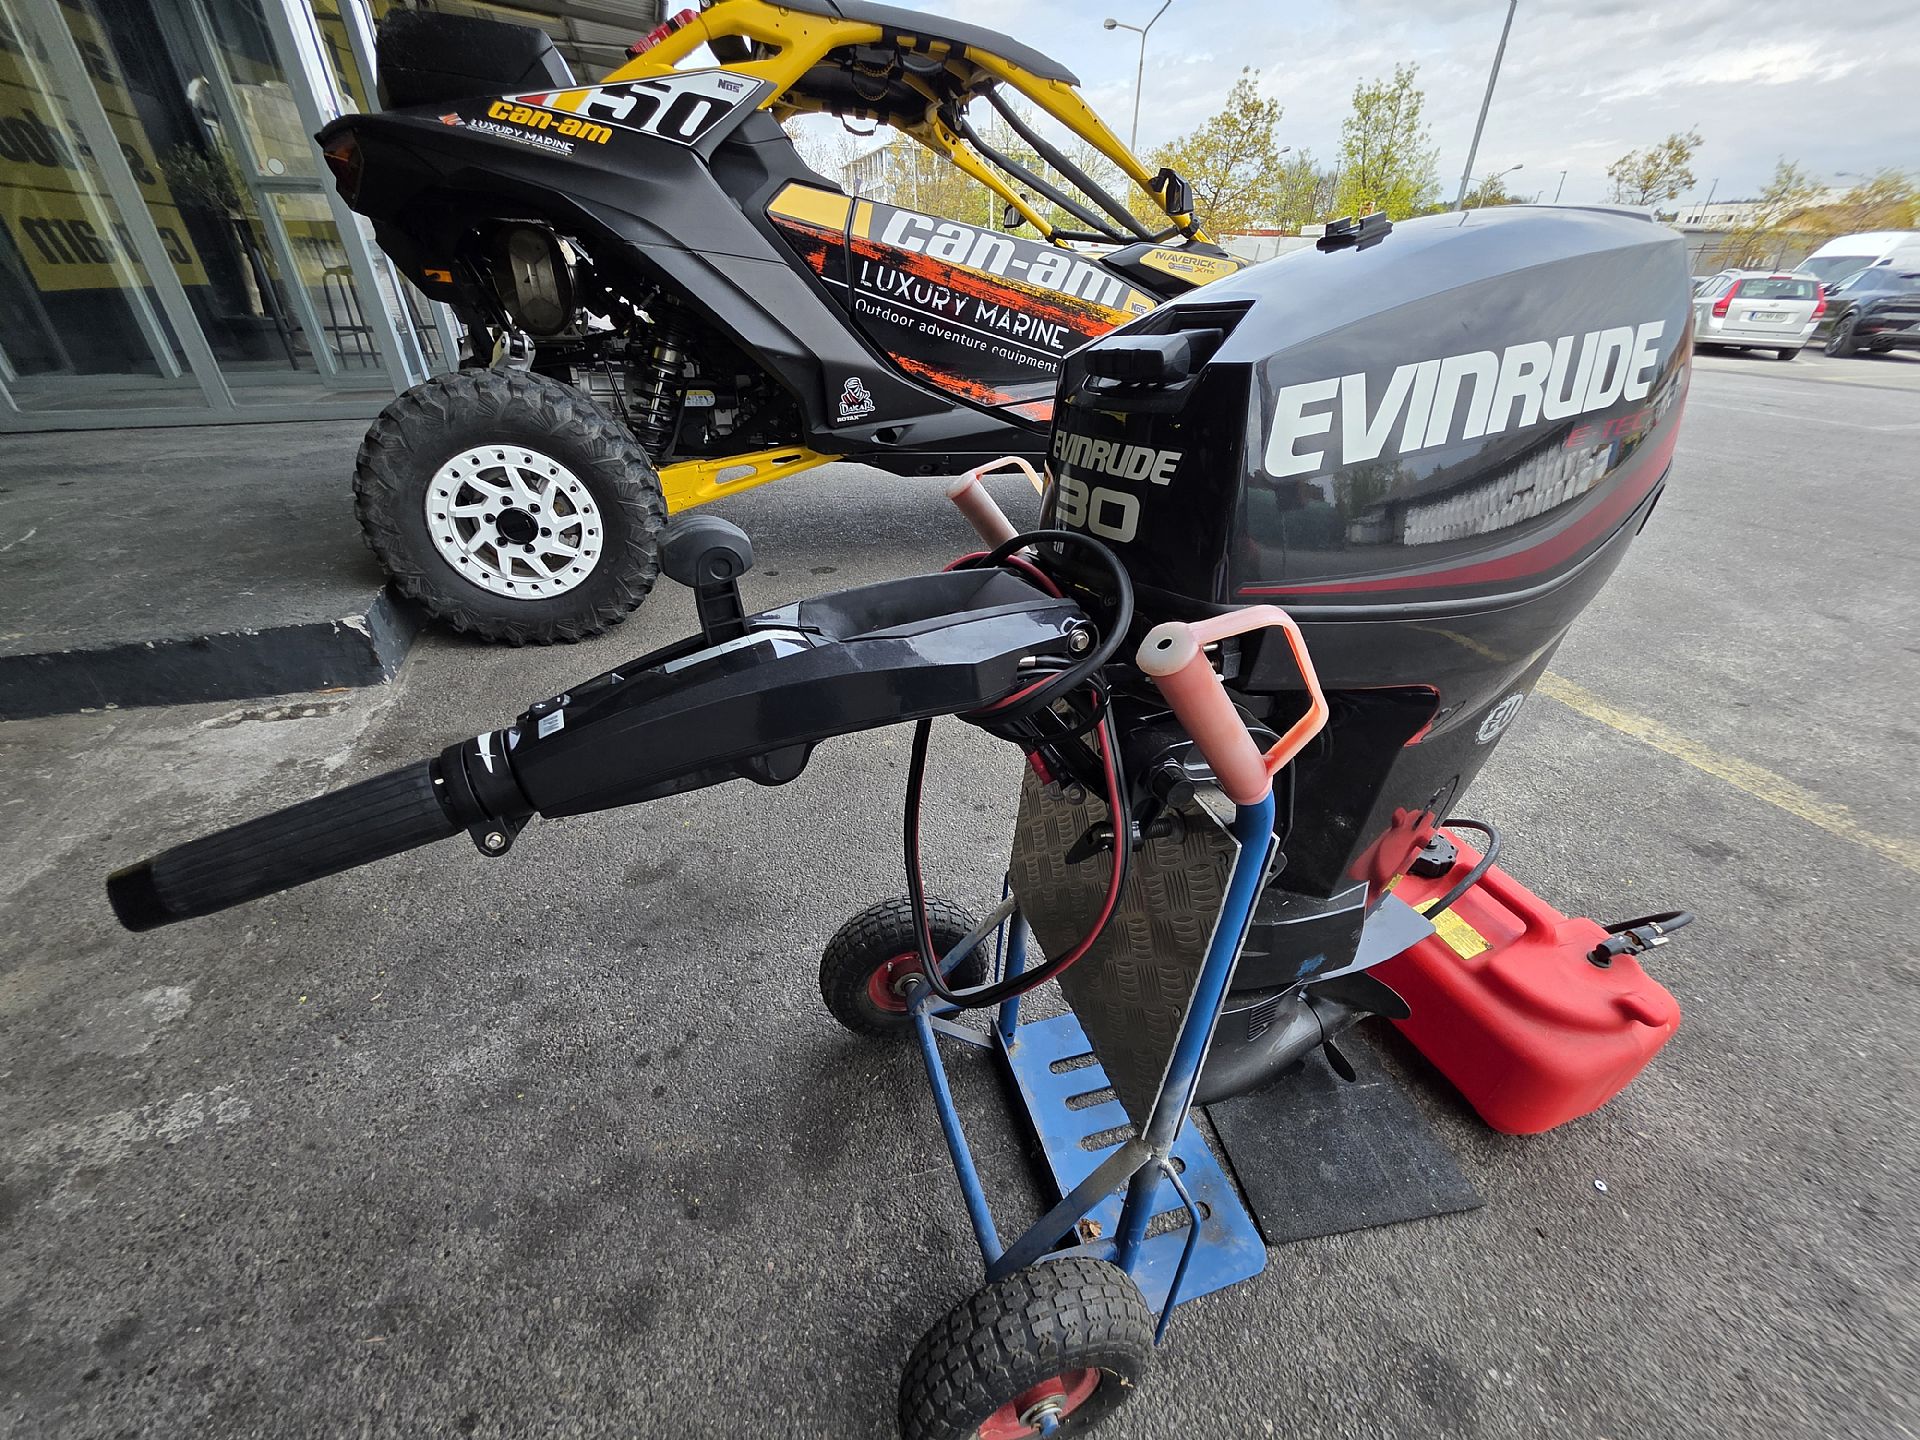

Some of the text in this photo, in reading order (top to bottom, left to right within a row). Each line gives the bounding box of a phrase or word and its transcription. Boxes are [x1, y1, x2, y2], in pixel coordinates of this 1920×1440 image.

[587, 80, 736, 145] 50
[717, 78, 740, 93] NOS
[470, 118, 524, 136] LUXURY
[524, 131, 575, 151] MARINE
[487, 101, 613, 145] can-am
[881, 210, 1124, 305] can-am
[1155, 251, 1215, 268] MAVERICK
[855, 298, 1058, 374] Outdoor adventure equipment
[860, 260, 1070, 350] LUXURY MARINE
[1264, 320, 1665, 478] EVINRUDE
[1053, 429, 1183, 486] EVINRUDE
[1055, 473, 1140, 543] 30
